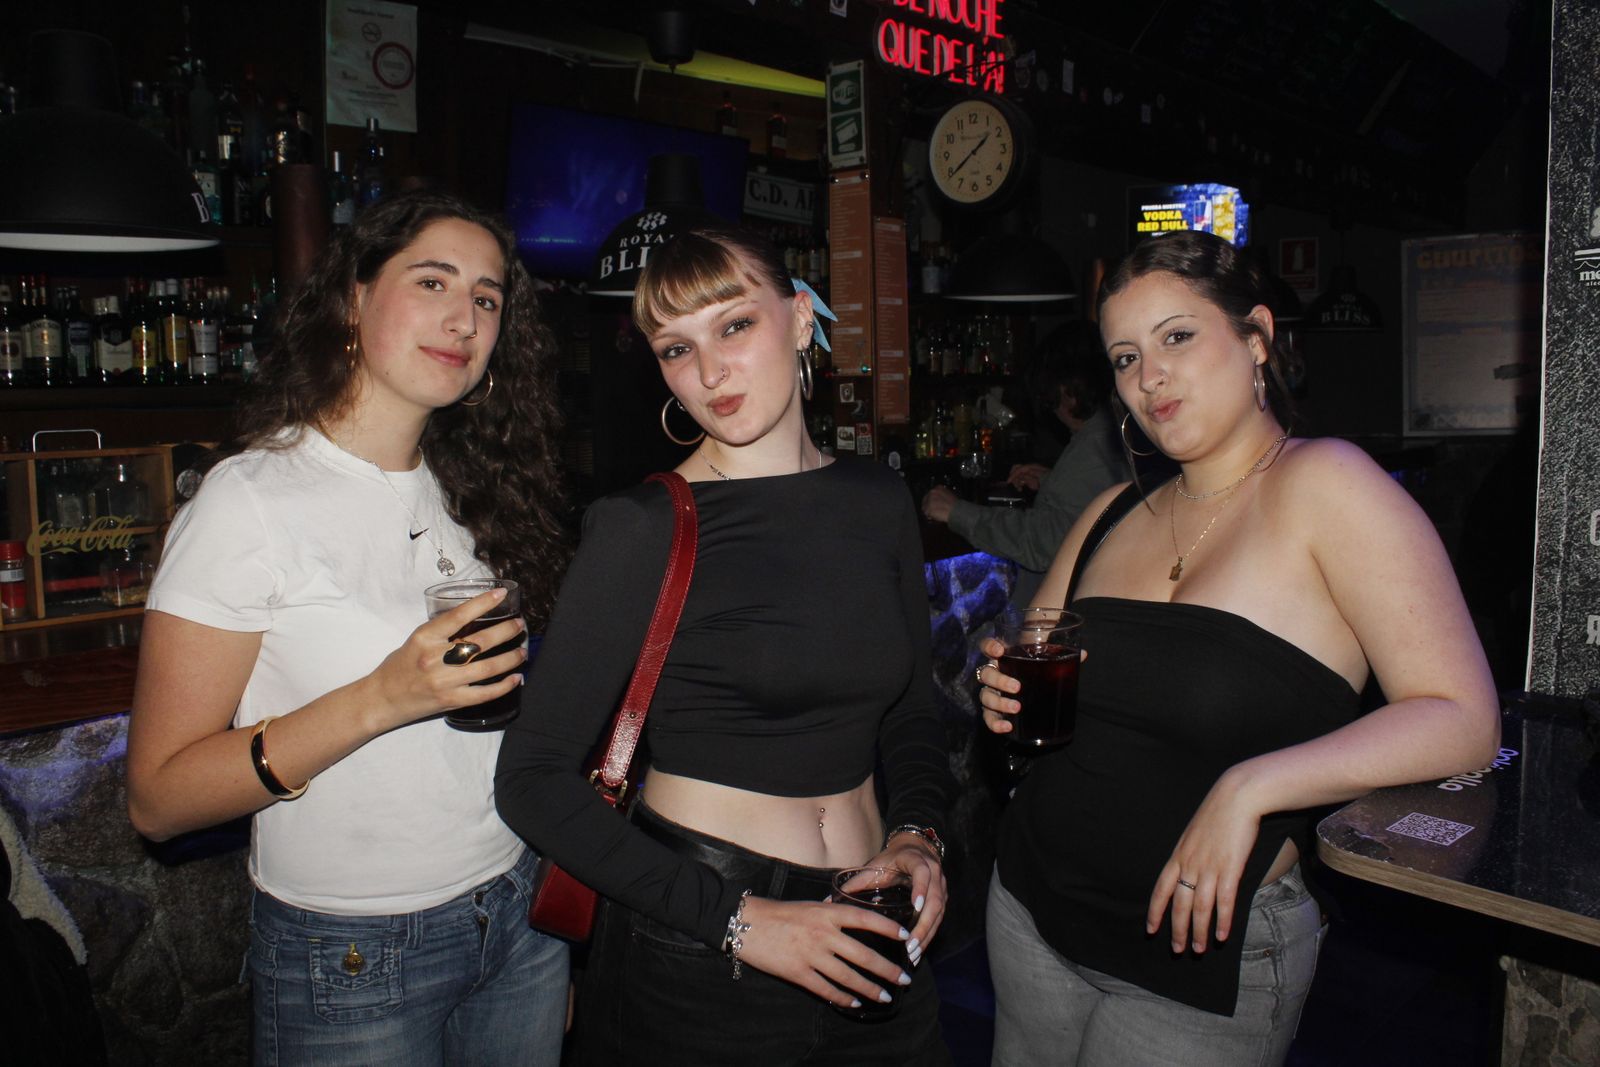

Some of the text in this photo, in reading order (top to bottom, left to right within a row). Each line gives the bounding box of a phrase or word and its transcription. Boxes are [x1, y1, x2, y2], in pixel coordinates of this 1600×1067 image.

[877, 18, 931, 75] QUE
[968, 113, 978, 124] 12
[957, 119, 964, 130] 11
[995, 126, 1002, 138] 2
[946, 133, 955, 144] 10
[1000, 143, 1007, 154] 3
[943, 151, 950, 160] 9
[995, 162, 1003, 171] 4
[947, 167, 954, 178] 8
[958, 177, 964, 189] 7
[985, 175, 993, 186] 5
[971, 182, 979, 192] 6
[1143, 210, 1183, 221] VODKA
[1137, 220, 1189, 232] RED BULL
[619, 232, 675, 249] ROYA
[599, 246, 652, 280] BLI
